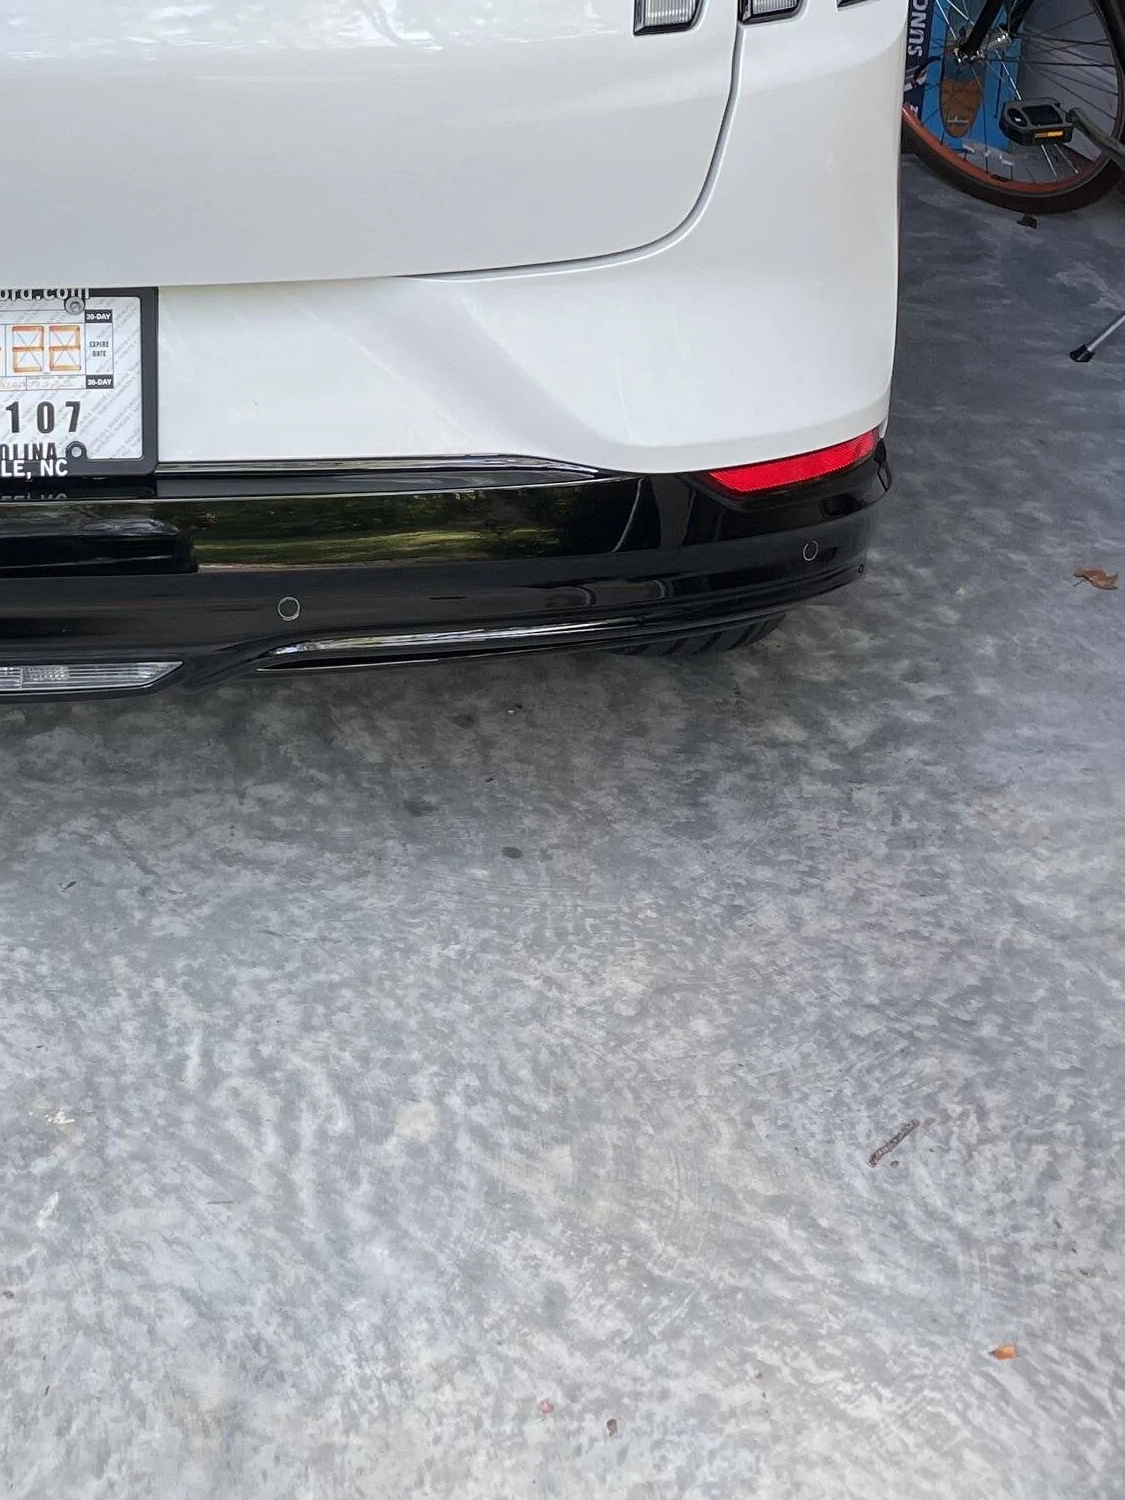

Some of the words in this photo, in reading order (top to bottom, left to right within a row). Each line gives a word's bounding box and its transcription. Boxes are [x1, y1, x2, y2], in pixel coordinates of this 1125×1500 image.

[86, 312, 111, 320] 30-DAY
[87, 378, 112, 386] 30-DAY
[40, 459, 68, 477] NC
